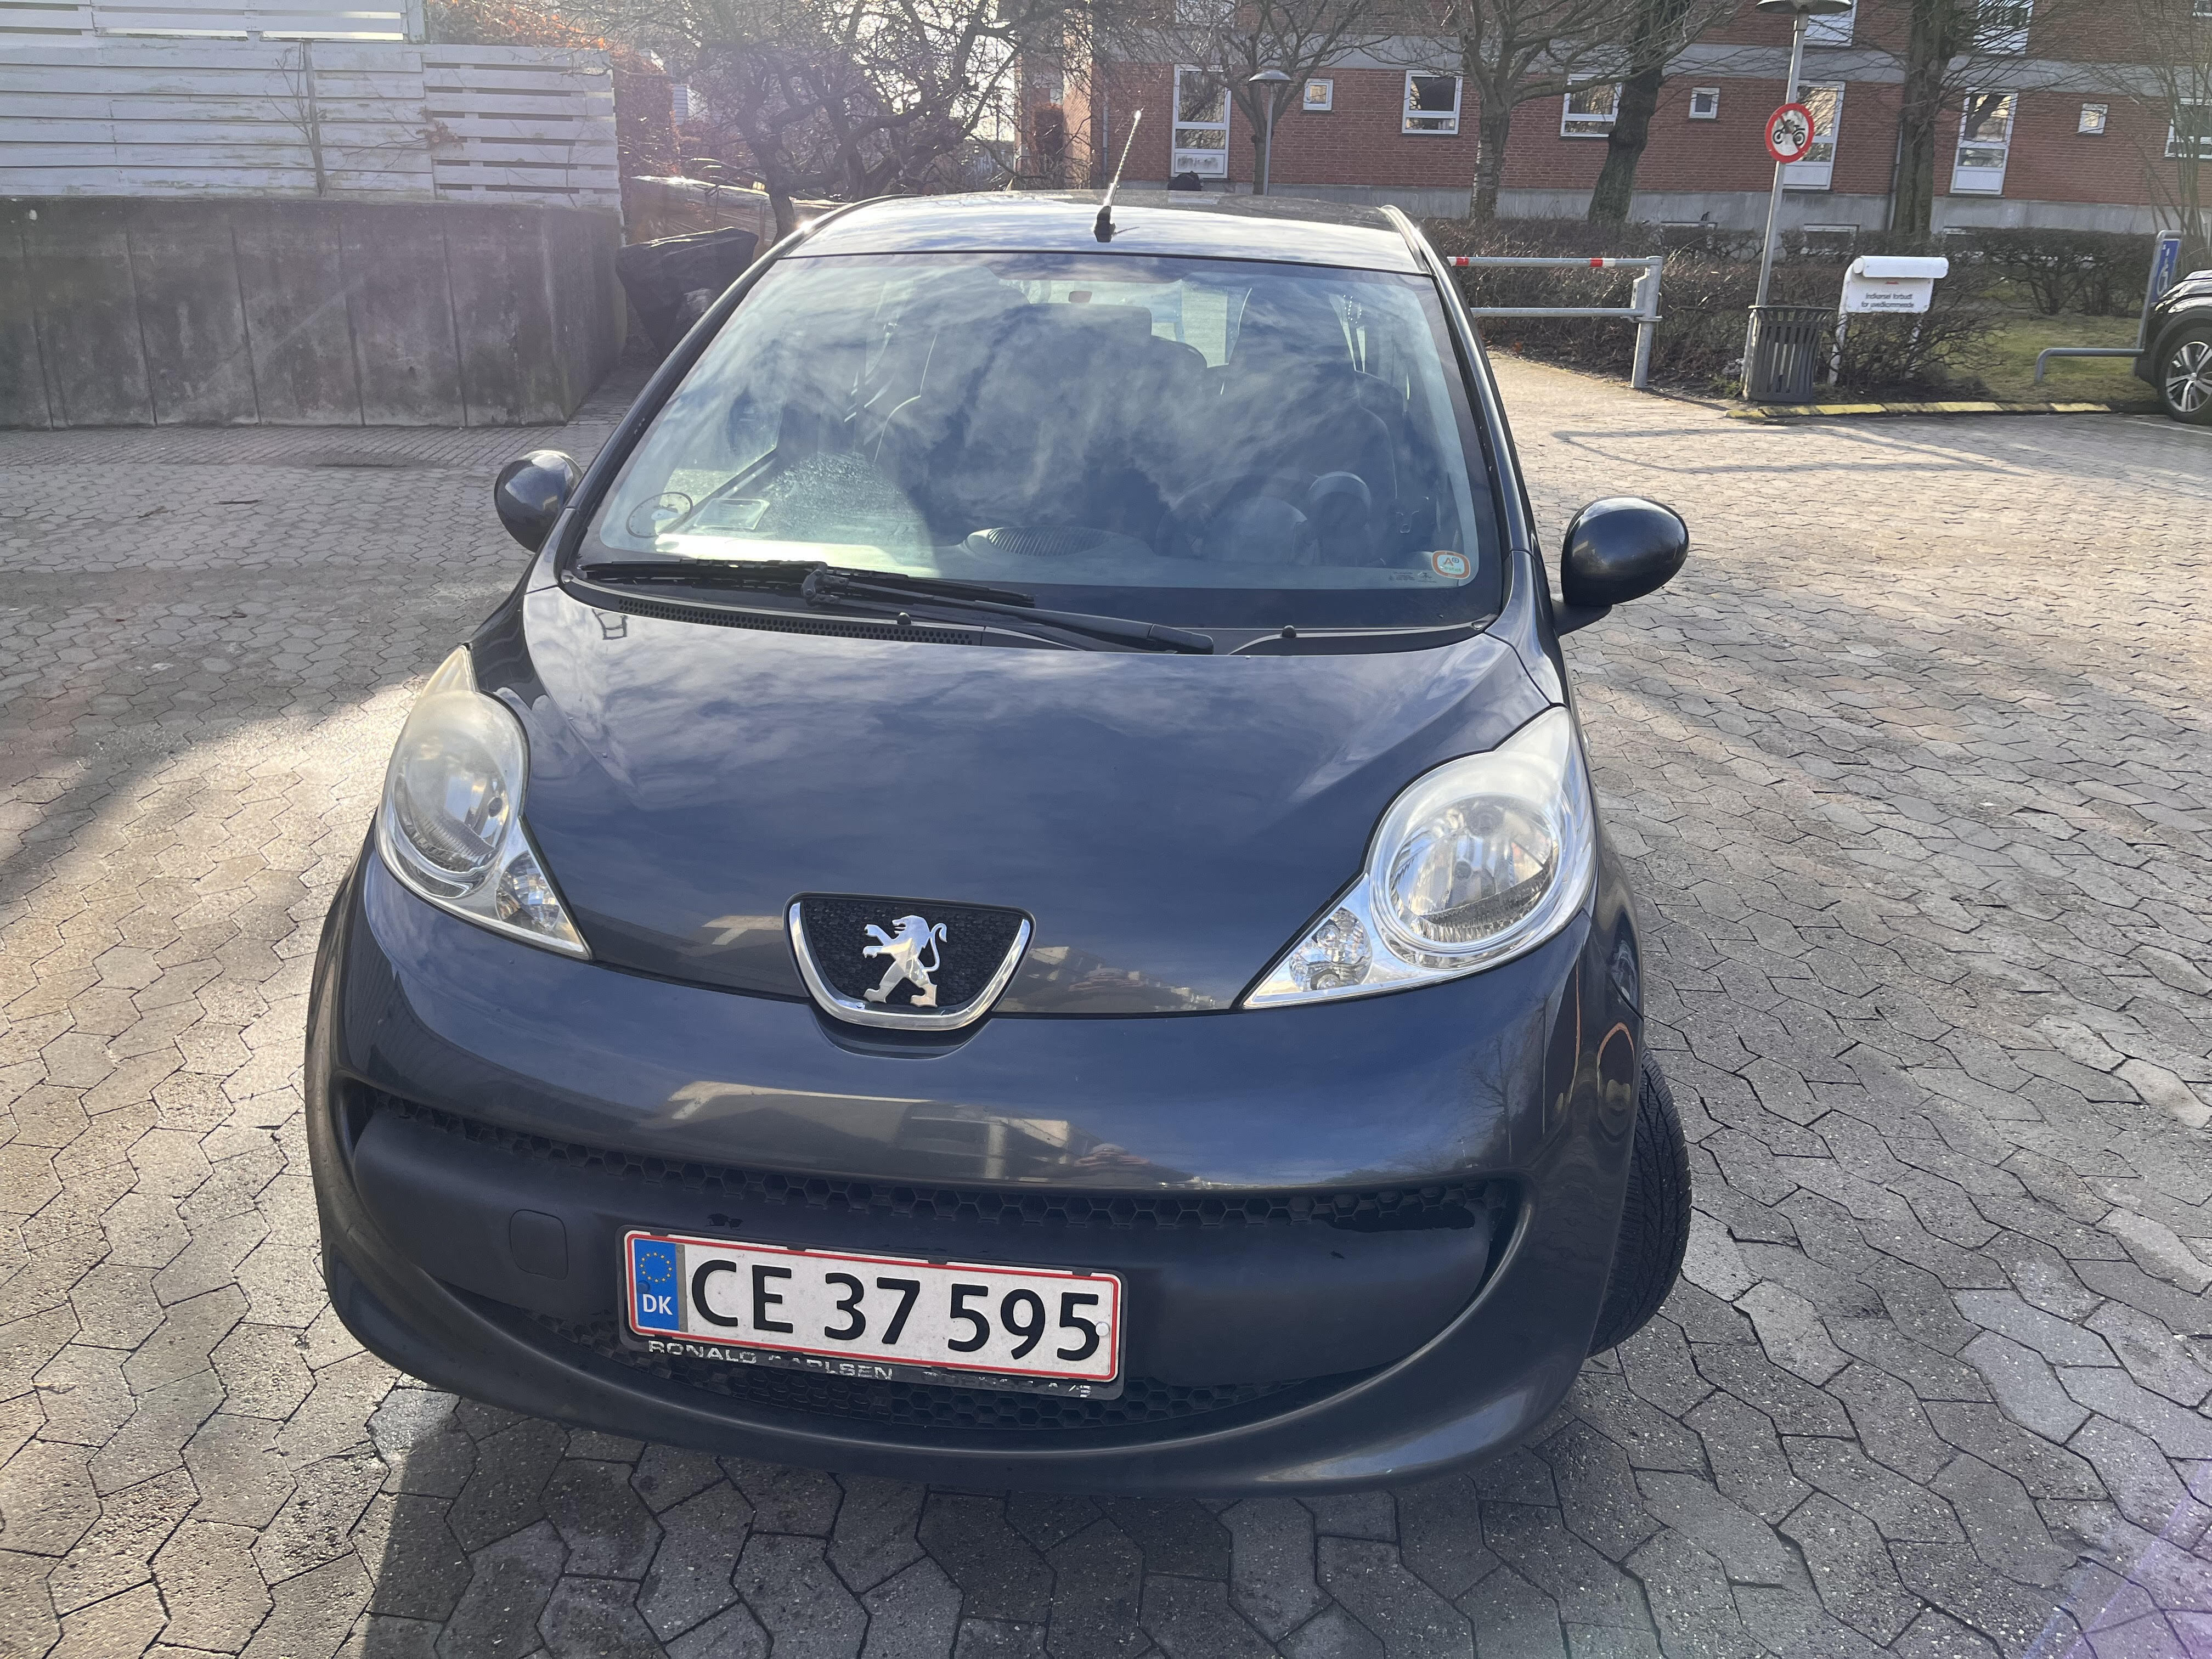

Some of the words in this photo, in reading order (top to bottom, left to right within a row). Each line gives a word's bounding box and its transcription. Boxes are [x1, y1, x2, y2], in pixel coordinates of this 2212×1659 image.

[642, 1293, 673, 1316] DK
[691, 1259, 793, 1333] CE
[824, 1272, 921, 1344] 37
[947, 1283, 1101, 1362] 595
